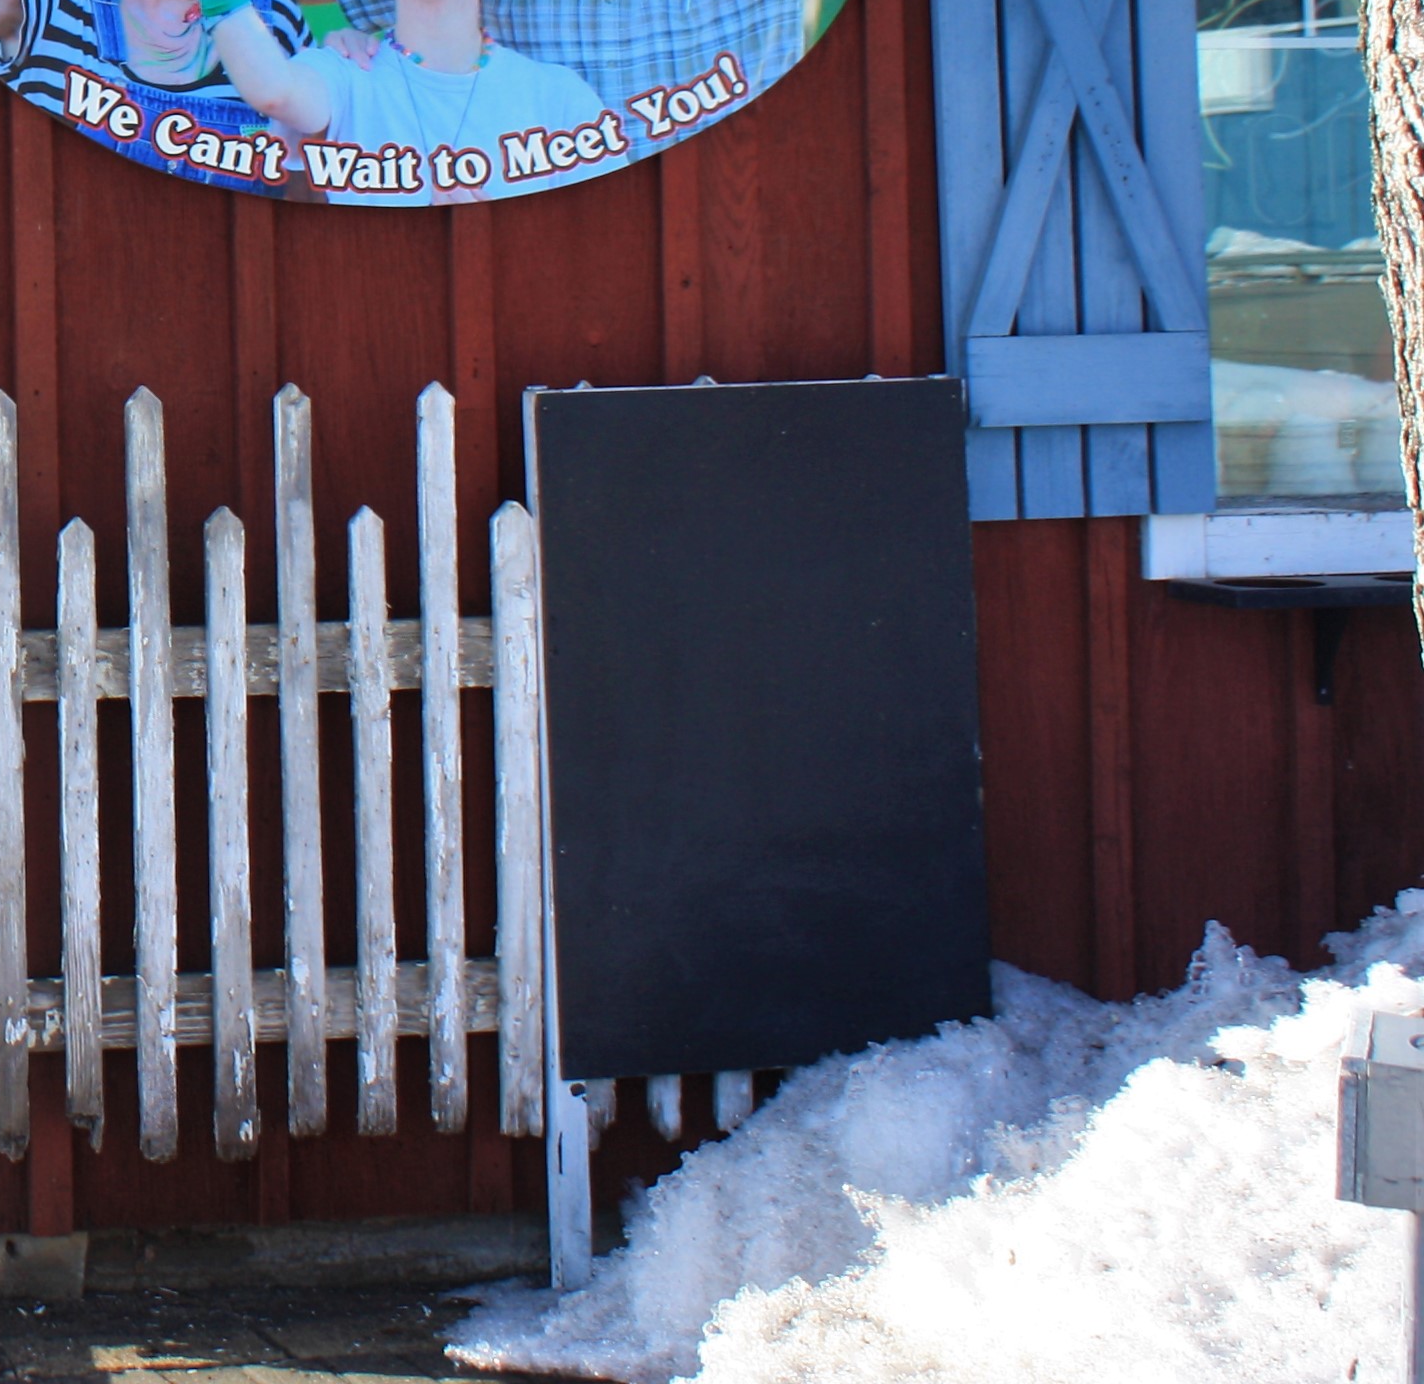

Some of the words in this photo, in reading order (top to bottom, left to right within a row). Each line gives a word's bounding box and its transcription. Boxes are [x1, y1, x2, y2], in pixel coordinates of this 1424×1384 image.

[66, 70, 143, 138] We
[153, 114, 286, 180] Can't
[303, 142, 423, 193] Wait
[435, 144, 489, 188] to
[502, 110, 626, 180] Meet
[630, 54, 748, 136] You!
